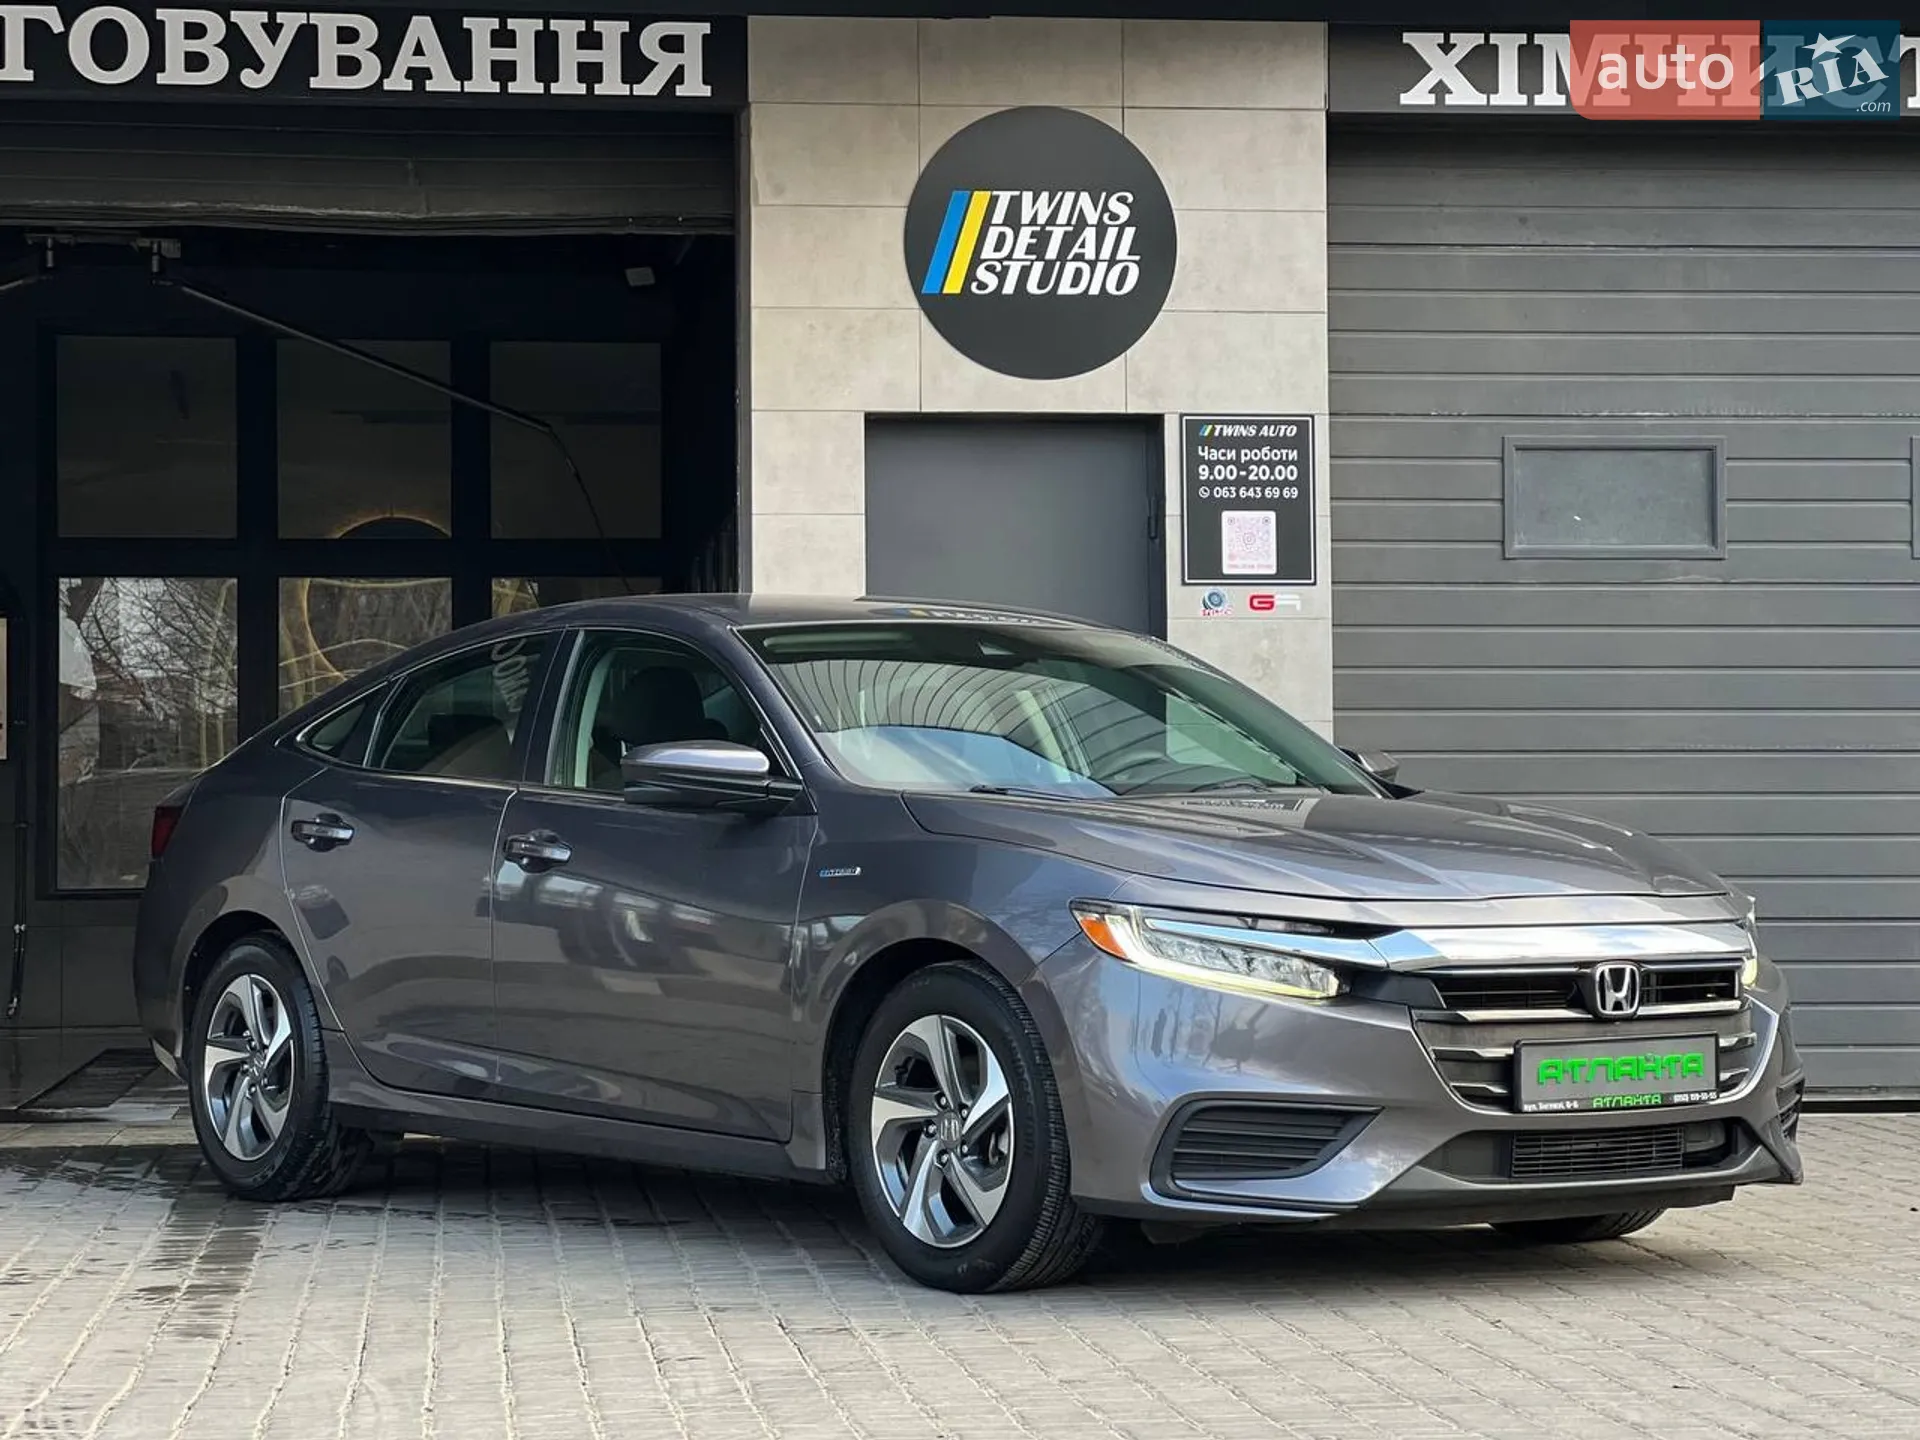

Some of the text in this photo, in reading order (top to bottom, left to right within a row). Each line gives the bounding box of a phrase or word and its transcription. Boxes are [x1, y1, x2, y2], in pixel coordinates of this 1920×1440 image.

[0, 5, 712, 97] ГОВУВАННЯ
[990, 190, 1134, 226] TWINS
[980, 226, 1141, 261] DETAIL
[970, 260, 1141, 296] STUDIO
[1213, 424, 1298, 437] TWINS AUTO
[1198, 445, 1298, 464] Часи роботи
[1213, 486, 1298, 499] 063 643 69 69
[1538, 1052, 1704, 1085] АТЛАНТА
